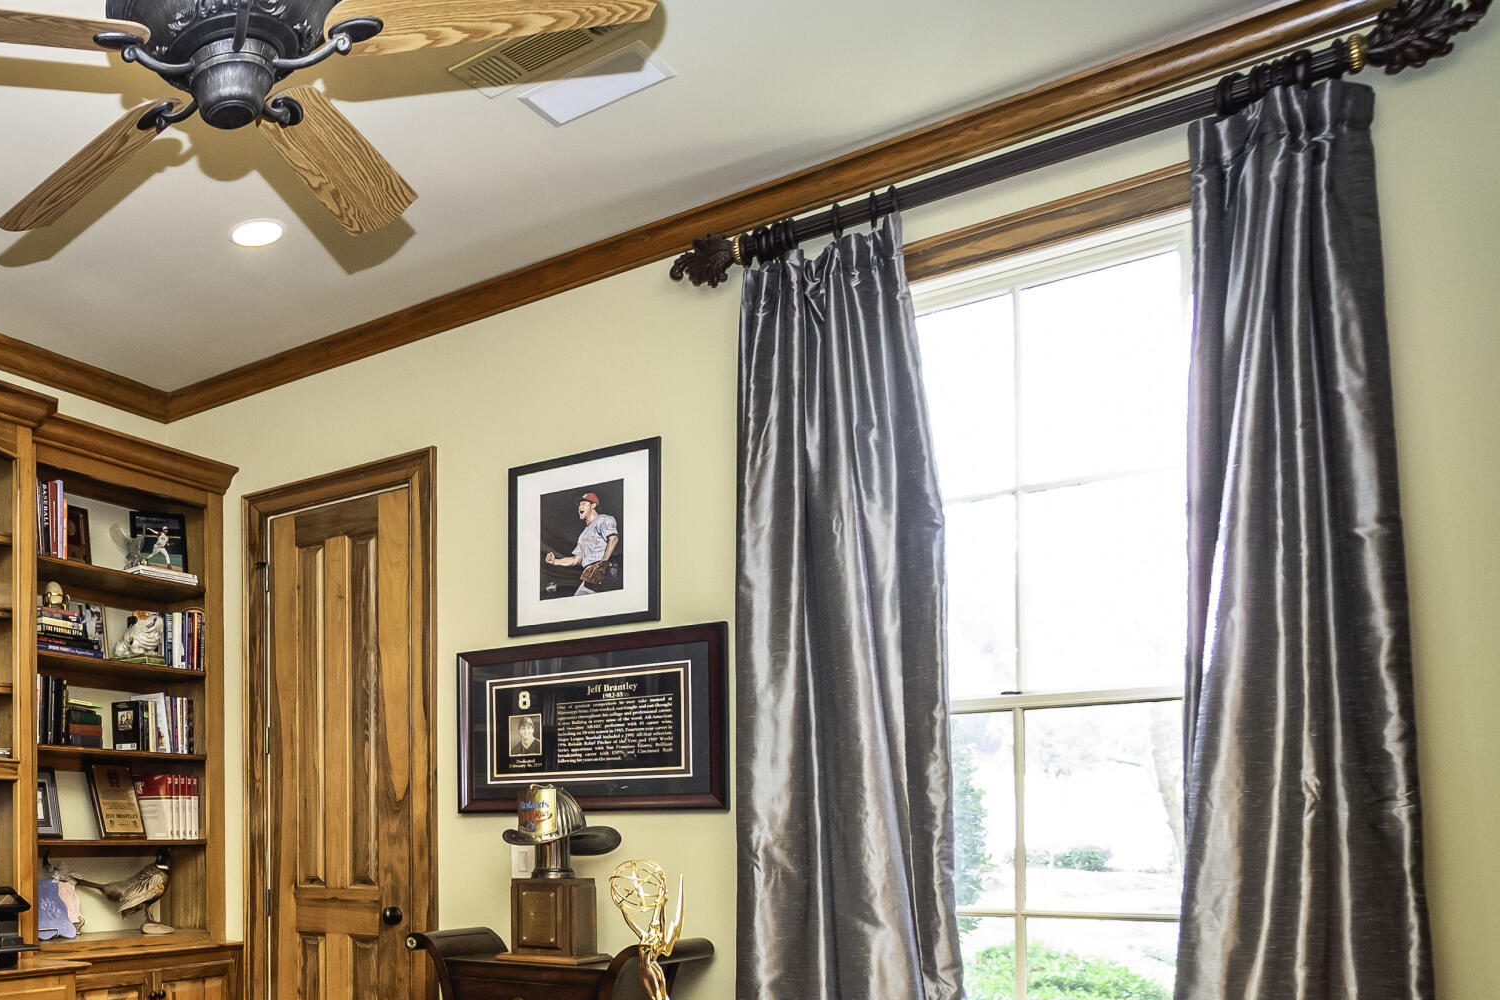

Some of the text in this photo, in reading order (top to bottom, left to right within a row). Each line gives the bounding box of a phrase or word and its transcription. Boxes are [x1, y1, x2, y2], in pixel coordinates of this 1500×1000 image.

[586, 681, 639, 696] Jeff Brantley
[518, 690, 531, 710] 8
